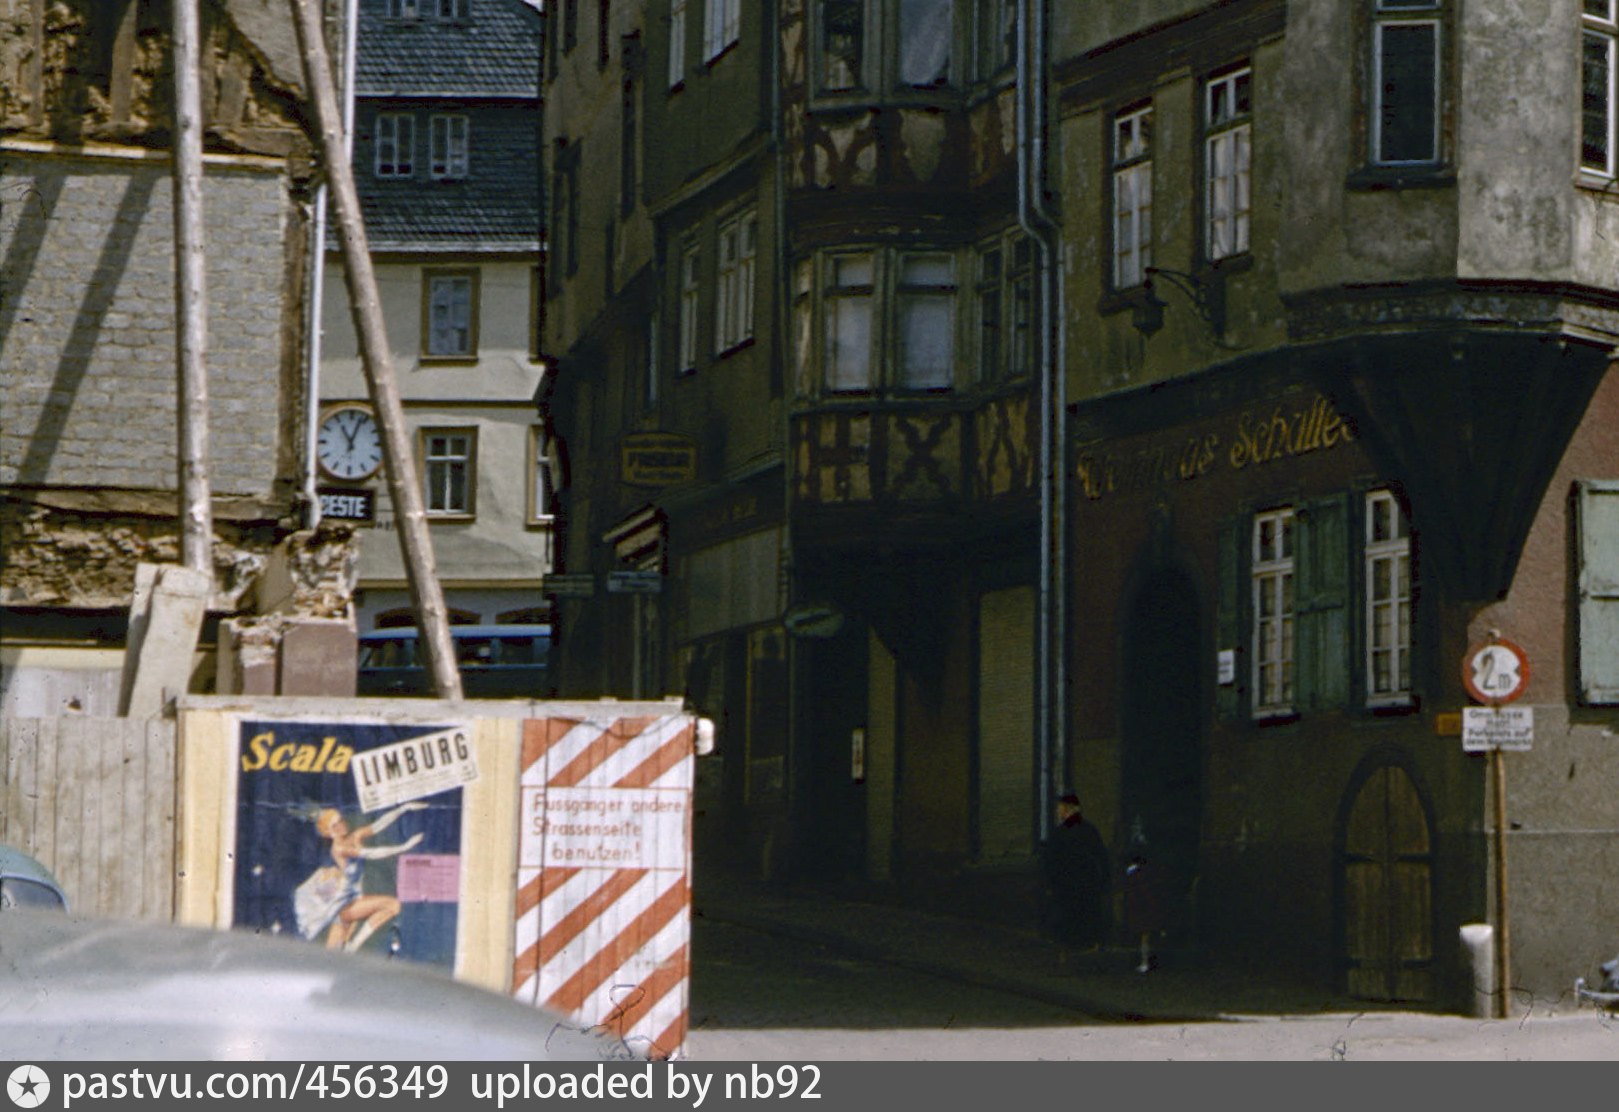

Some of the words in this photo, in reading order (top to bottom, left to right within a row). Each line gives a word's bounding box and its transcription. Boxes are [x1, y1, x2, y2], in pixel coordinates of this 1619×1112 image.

[241, 731, 355, 773] Scala
[359, 732, 468, 786] LIMBURG
[631, 795, 682, 813] andere
[532, 816, 643, 837] Strassenseite
[551, 840, 642, 861] benutzen!
